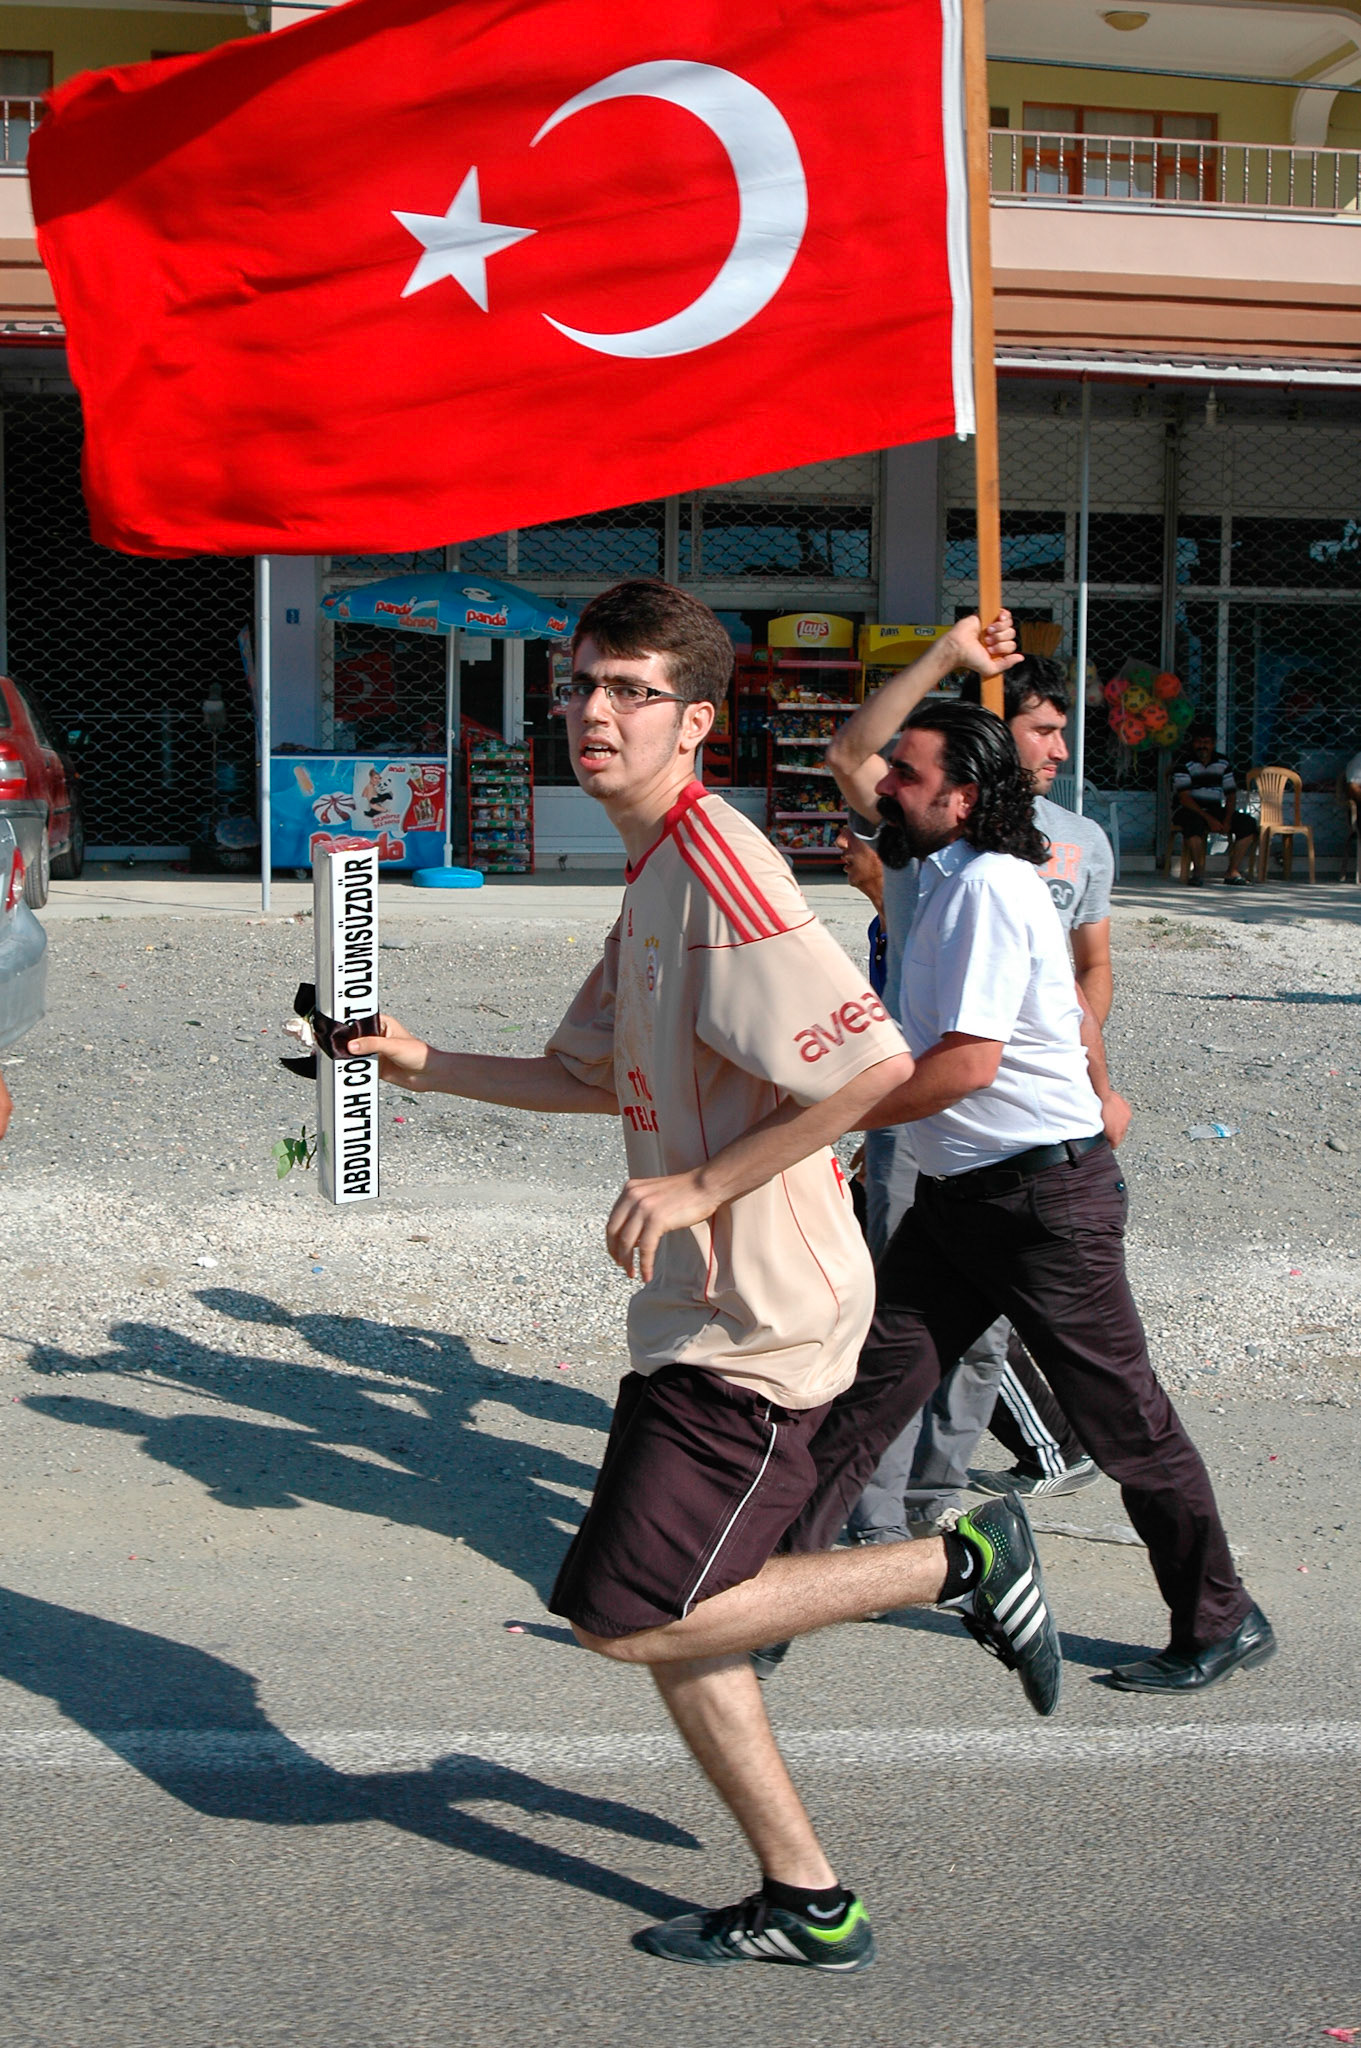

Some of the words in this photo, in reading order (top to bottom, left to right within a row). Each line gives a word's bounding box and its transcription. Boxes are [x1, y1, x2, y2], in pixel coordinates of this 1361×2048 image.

[466, 609, 507, 626] panda
[337, 856, 373, 998] ÖLÜMSÜZDÜR
[337, 1006, 372, 1087] CÖT
[793, 991, 891, 1063] avea
[343, 1094, 371, 1195] ABDULLAH
